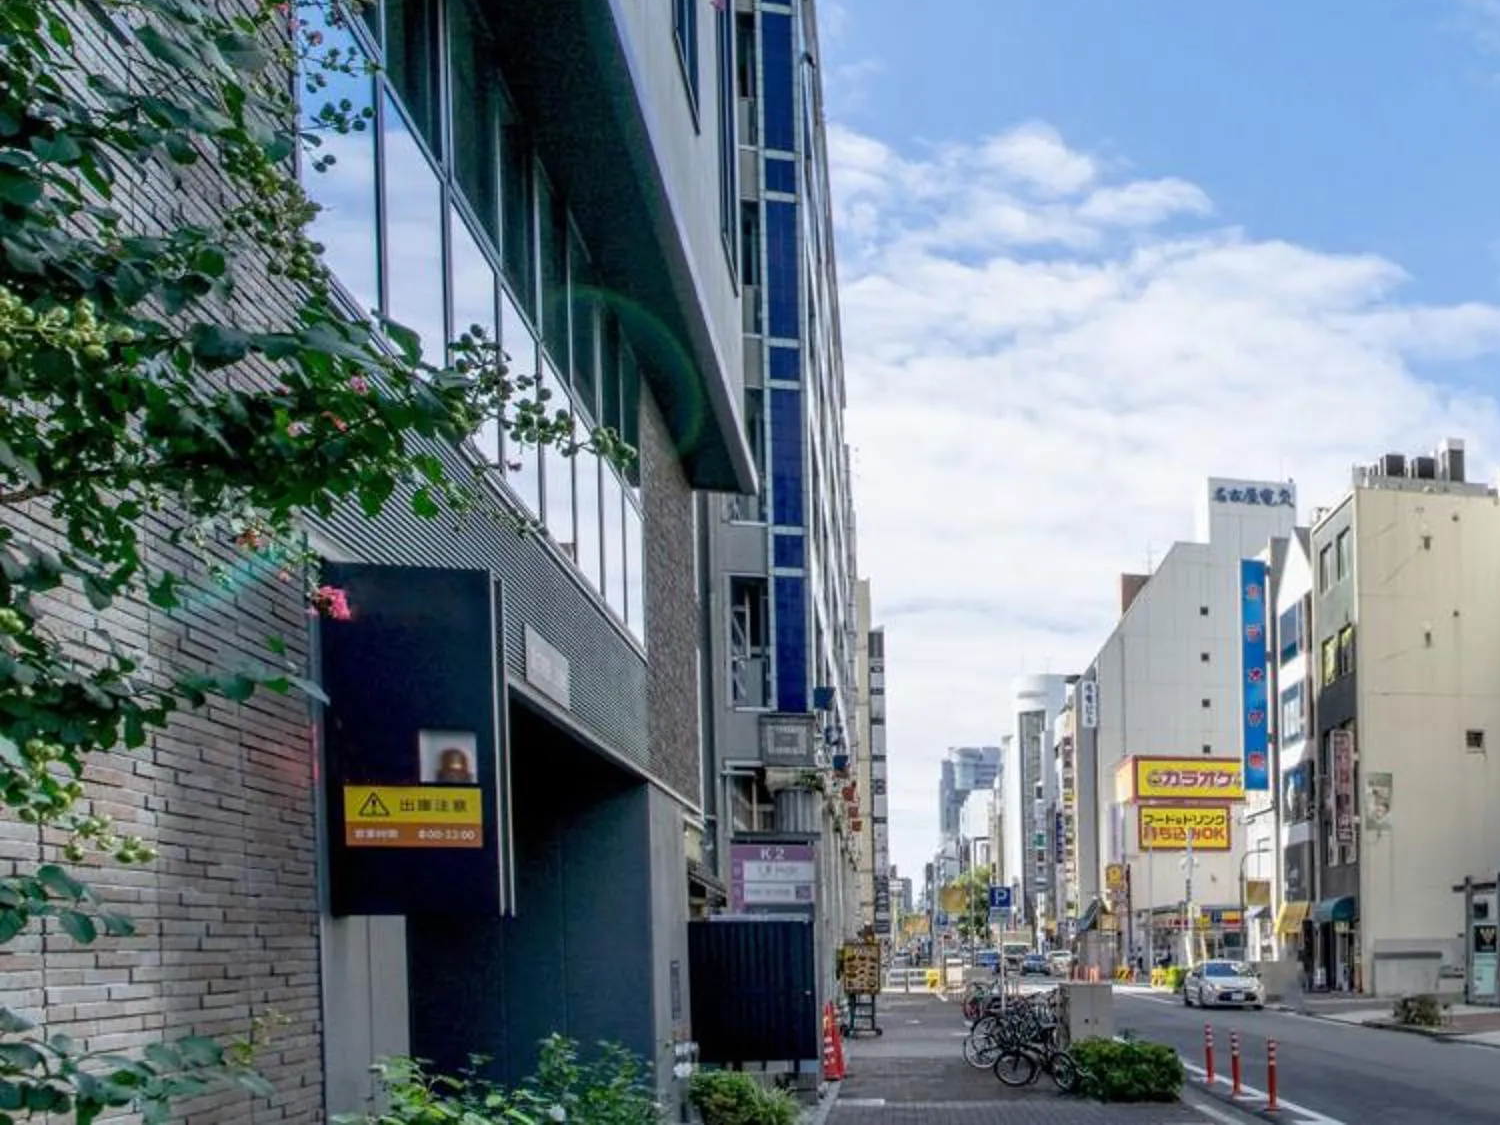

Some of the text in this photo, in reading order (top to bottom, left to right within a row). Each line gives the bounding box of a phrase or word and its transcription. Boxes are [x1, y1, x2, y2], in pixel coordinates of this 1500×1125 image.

[1162, 769, 1233, 788] カラオケ
[995, 888, 1008, 905] P
